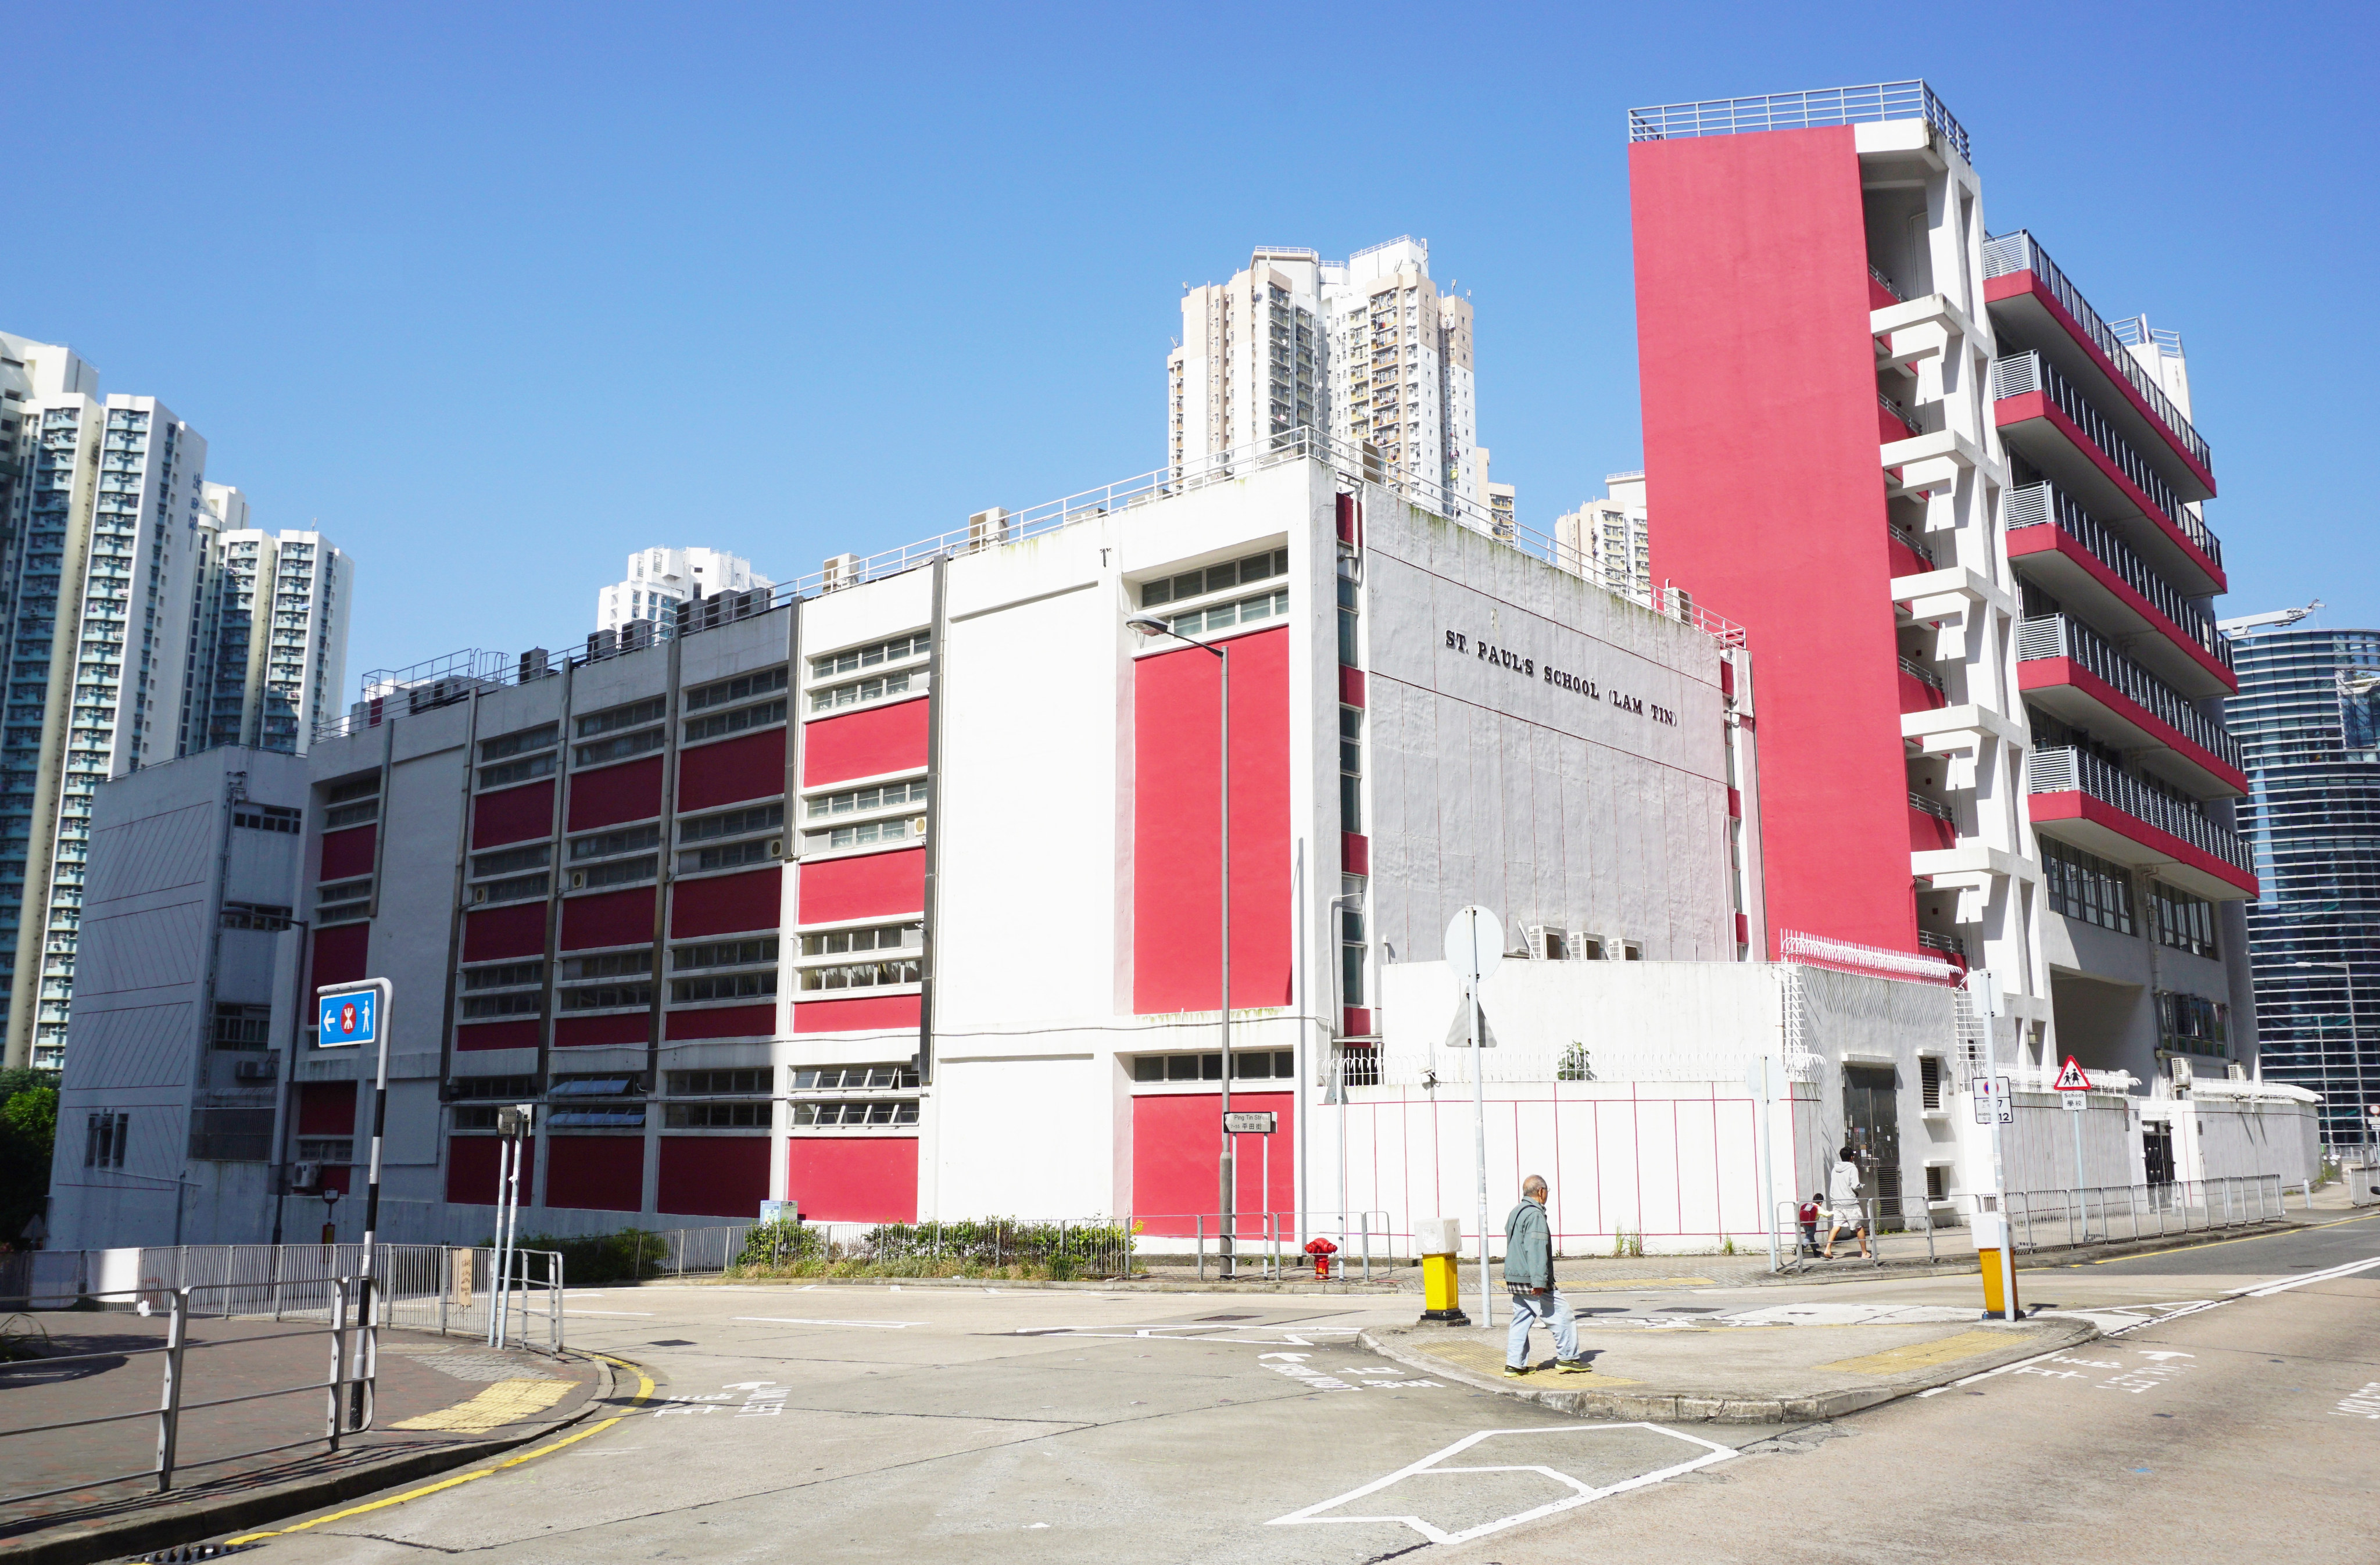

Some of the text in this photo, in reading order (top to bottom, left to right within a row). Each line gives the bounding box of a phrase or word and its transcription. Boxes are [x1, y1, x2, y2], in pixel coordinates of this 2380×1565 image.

[1445, 629, 1677, 726] ST. PAUL'S SCHOOL (LAM TIN)
[1998, 1100, 2002, 1108] 7
[1258, 1363, 1364, 1392] LOOK RIGHT
[734, 1399, 787, 1418] LEFT
